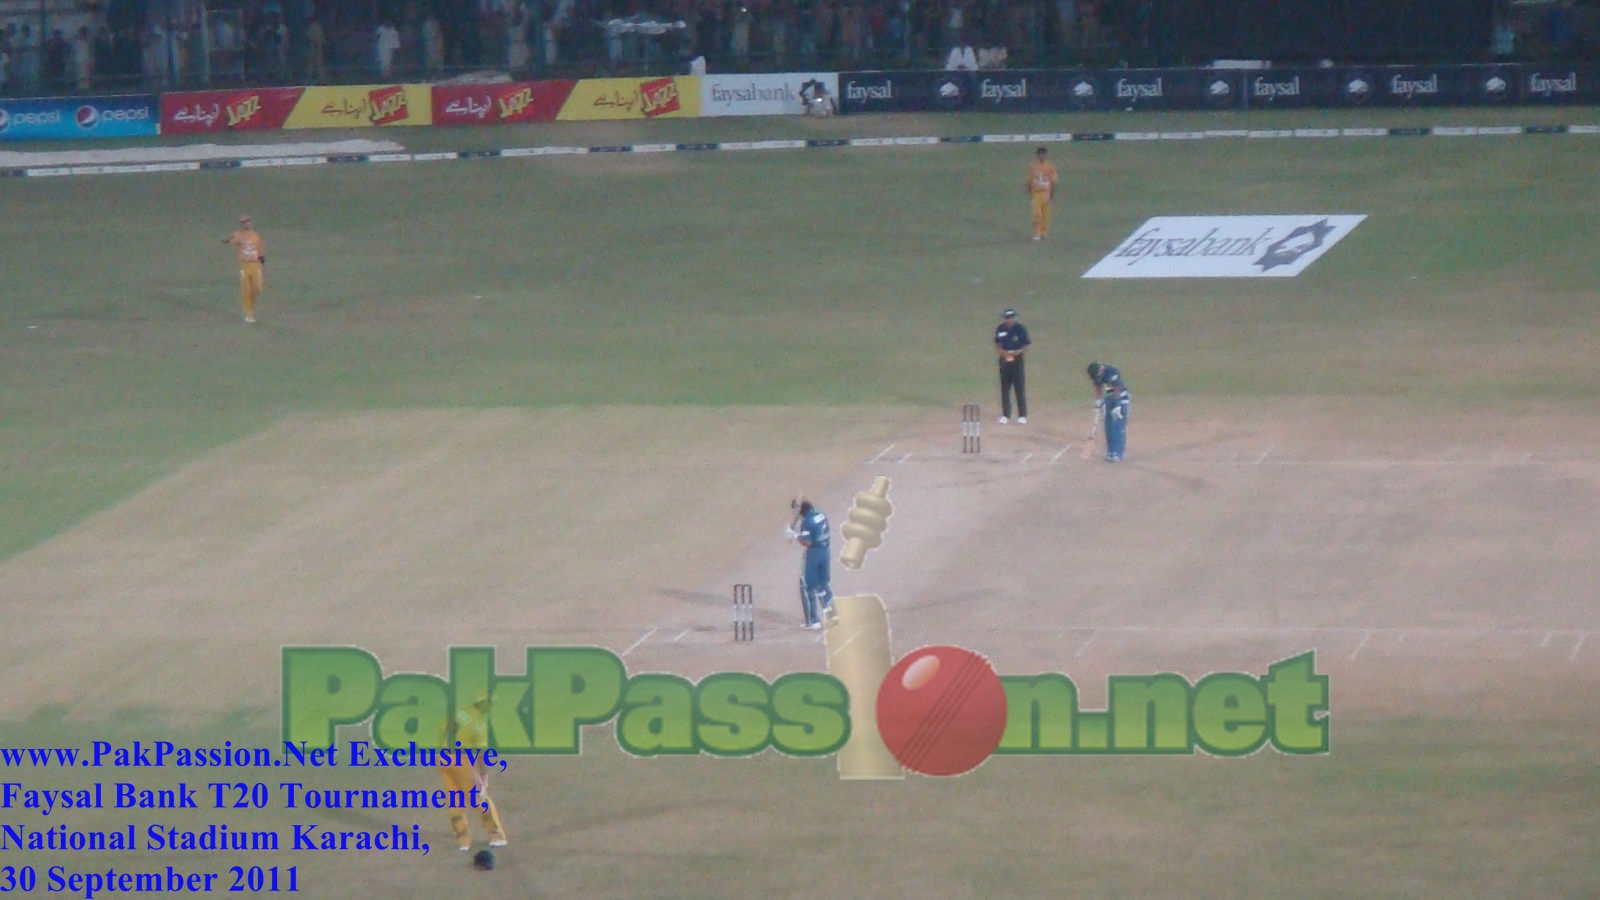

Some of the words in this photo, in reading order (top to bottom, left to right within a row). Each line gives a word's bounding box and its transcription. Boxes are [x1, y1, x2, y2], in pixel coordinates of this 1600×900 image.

[847, 80, 893, 102] faysal
[981, 78, 1027, 102] faysal
[1117, 78, 1163, 102] faysal
[1254, 76, 1300, 100] faysal
[1391, 74, 1438, 98] faysal
[1529, 73, 1577, 97] faysal
[13, 110, 60, 126] pepsi
[102, 106, 149, 123] pepsi
